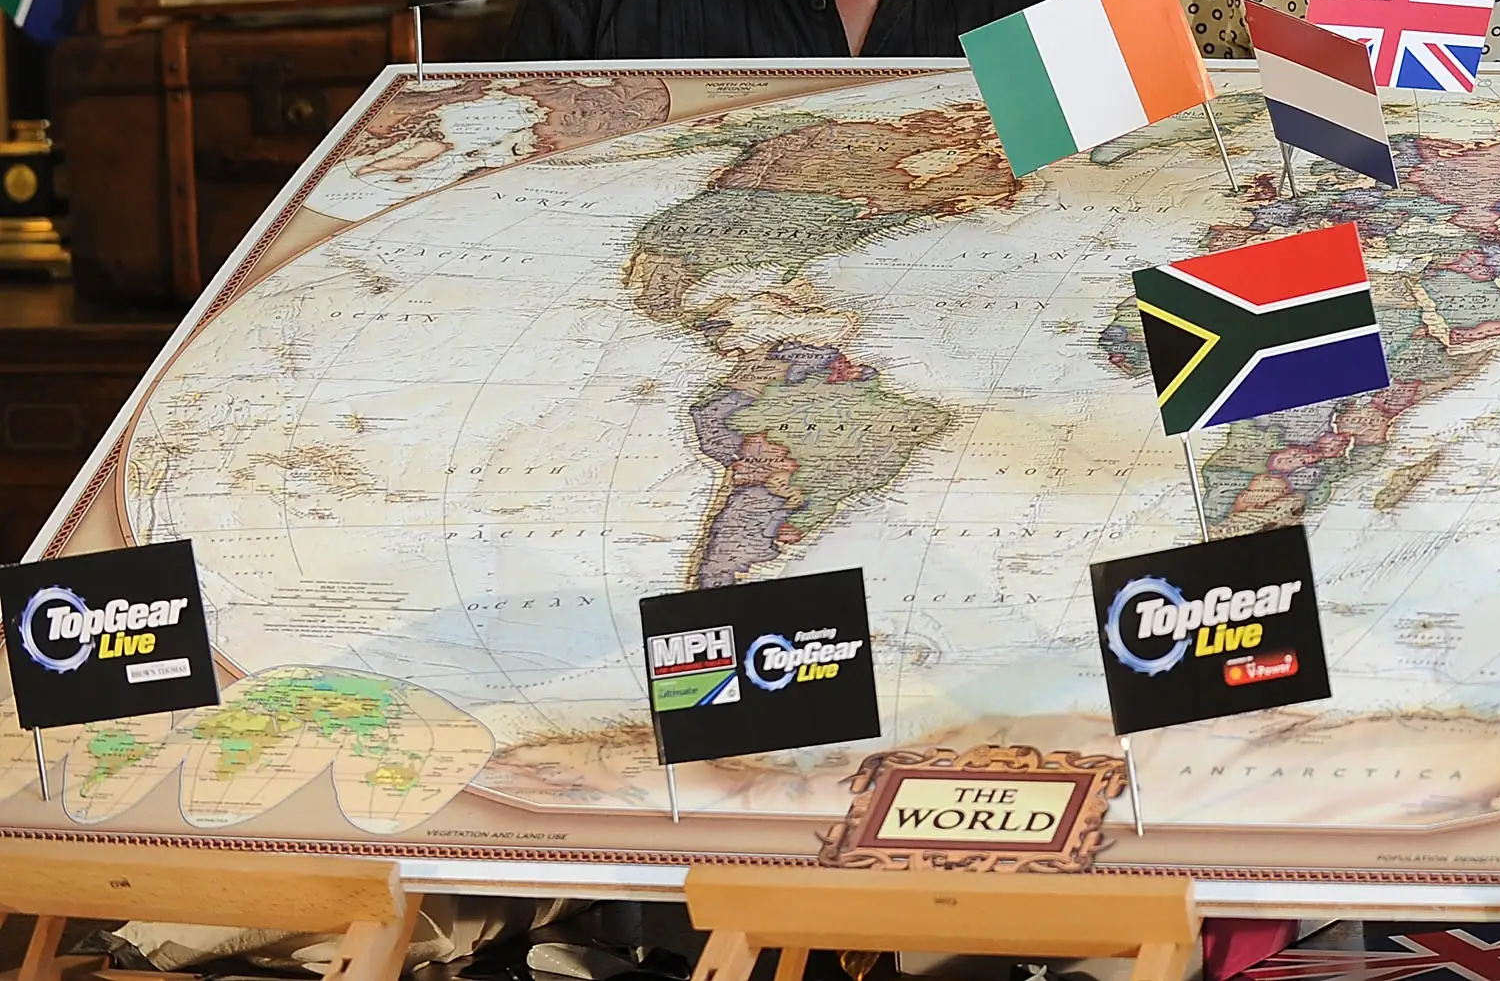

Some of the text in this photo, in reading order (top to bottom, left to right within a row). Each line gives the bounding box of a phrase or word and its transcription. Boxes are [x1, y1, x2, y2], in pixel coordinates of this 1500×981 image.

[491, 191, 601, 209] NORTH
[1057, 202, 1172, 214] NORTH
[660, 225, 748, 235] UNITED
[393, 247, 536, 265] PACIFIC
[954, 250, 1140, 262] ATLANTIC
[934, 300, 1052, 310] OCEAN
[330, 311, 438, 323] OCEAN
[779, 423, 921, 433] BRAZIL
[444, 464, 567, 475] SOUTH
[995, 467, 1133, 477] SOUTH
[444, 528, 614, 540] PACIFIC
[901, 528, 1124, 540] ATLANTIC
[467, 595, 597, 611] OCEAN
[903, 593, 1043, 604] OCEAN
[1136, 580, 1302, 640] TopGear
[46, 597, 188, 644] TopGear
[98, 631, 156, 659] Live
[1195, 622, 1263, 658] Live
[652, 628, 732, 668] MPH
[762, 639, 864, 672] TopGear
[796, 662, 840, 683] Live
[1179, 765, 1463, 780] ANTARCTICA
[954, 786, 1019, 805] THE
[895, 806, 1056, 833] WORLD
[426, 829, 570, 841] VEGETATION AND LAND USE
